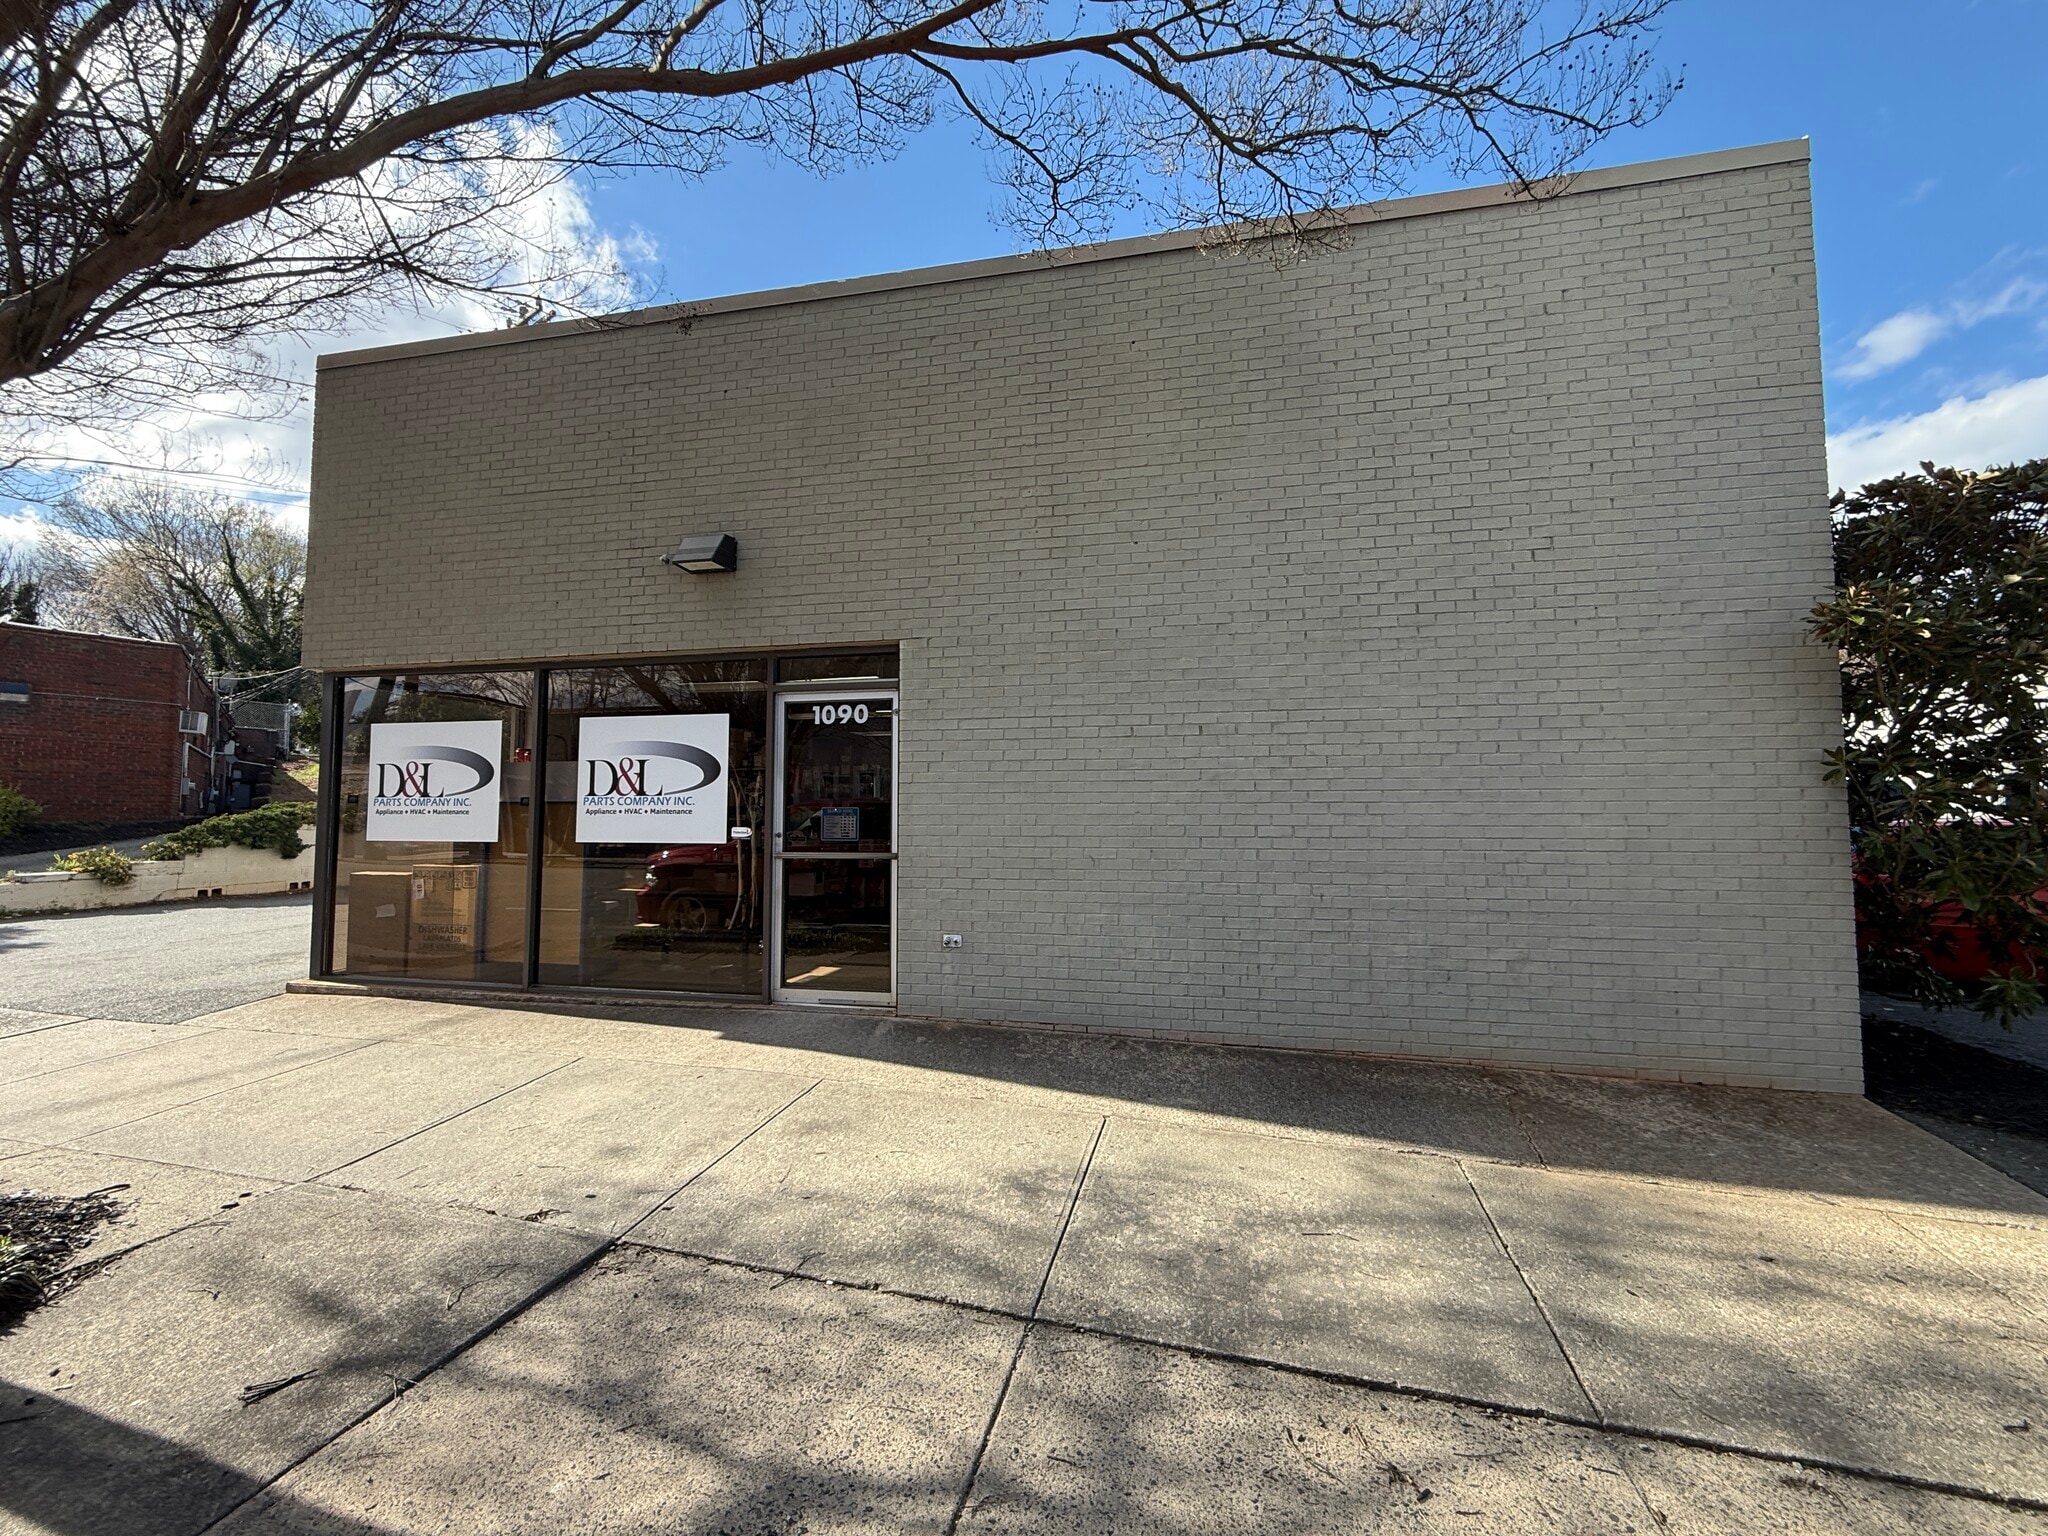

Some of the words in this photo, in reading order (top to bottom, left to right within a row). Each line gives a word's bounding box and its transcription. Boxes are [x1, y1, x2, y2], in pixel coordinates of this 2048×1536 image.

[812, 704, 869, 725] 1090
[376, 761, 445, 798] D&L
[585, 757, 663, 796] D&L
[373, 798, 402, 807] PARTS
[403, 798, 452, 807] COMPANY
[453, 798, 472, 807] INC.
[583, 797, 615, 806] PARTS
[617, 797, 672, 806] COMPANY
[673, 796, 696, 806] INC.
[585, 808, 617, 816] Appliance
[418, 925, 468, 935] DISHWASHER
